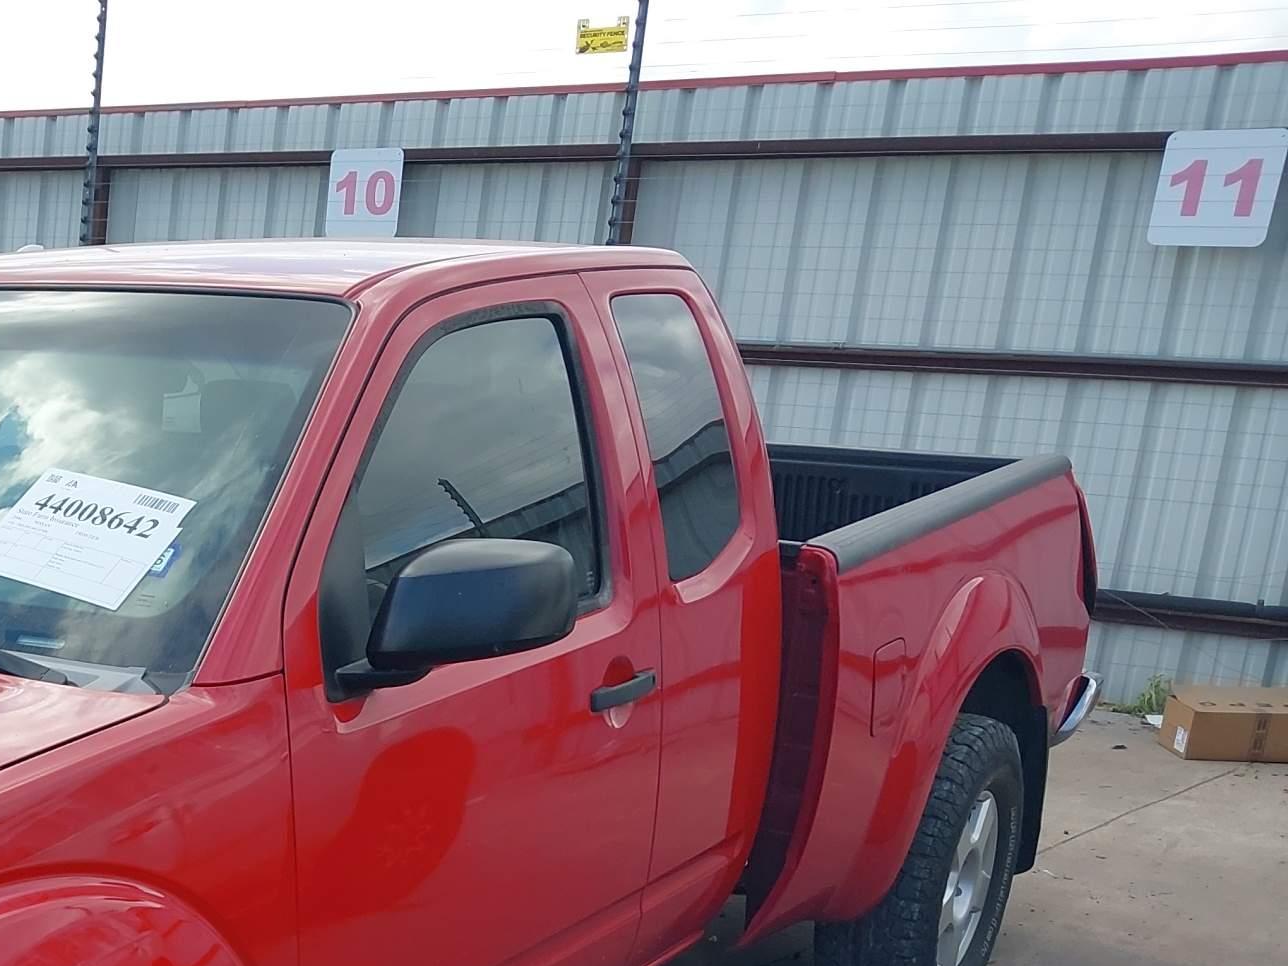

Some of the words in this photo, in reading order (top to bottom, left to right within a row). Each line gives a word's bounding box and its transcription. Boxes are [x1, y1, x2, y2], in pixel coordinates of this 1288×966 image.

[335, 170, 396, 216] 10
[1169, 158, 1264, 217] 11
[34, 493, 160, 539] 44008642
